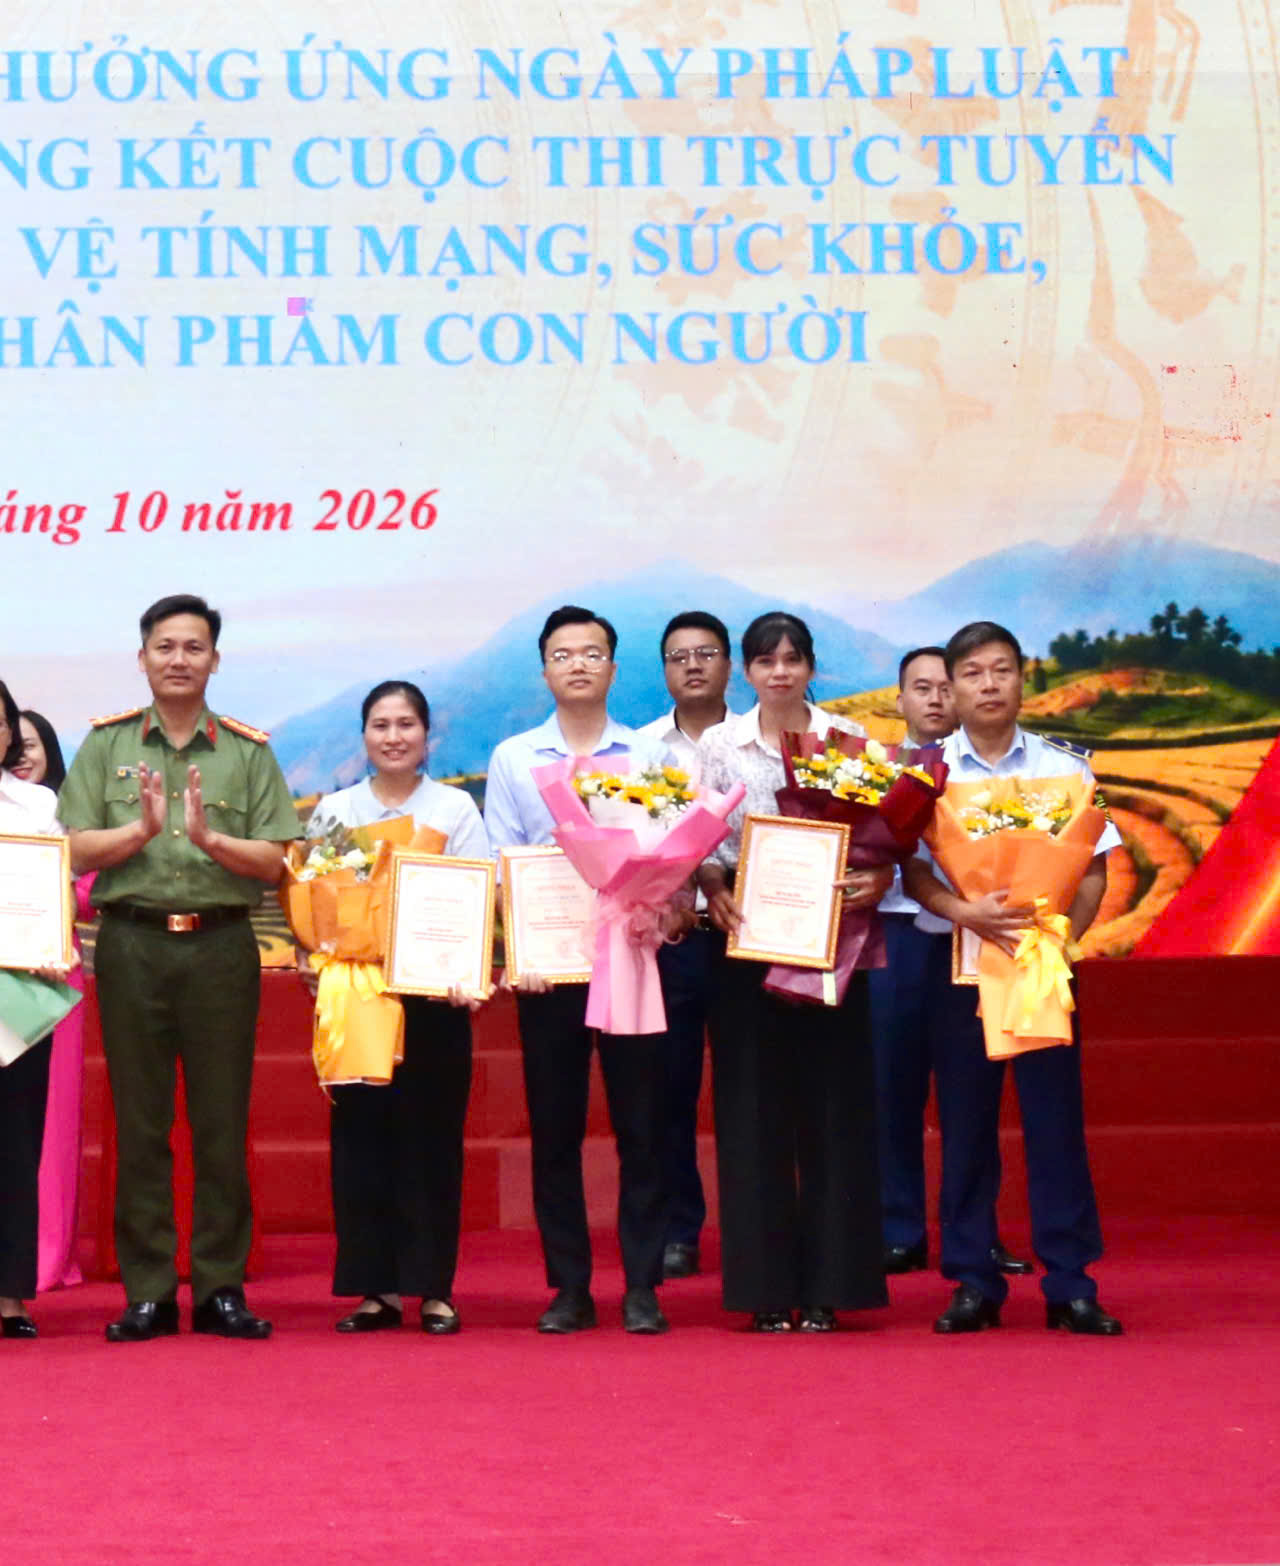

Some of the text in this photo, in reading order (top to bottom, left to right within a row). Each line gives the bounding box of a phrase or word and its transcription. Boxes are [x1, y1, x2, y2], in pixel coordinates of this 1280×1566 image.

[282, 31, 453, 102] ỨNG
[474, 30, 693, 101] NGÀY
[711, 30, 914, 100] PHÁP
[929, 36, 1130, 114] LUẬT
[116, 119, 274, 191] KẾT
[291, 127, 511, 205] CUỘC
[531, 134, 666, 189] THI
[685, 125, 902, 202] TRỰC
[920, 116, 1178, 188] TUYẾN
[17, 216, 119, 295] VỆ
[139, 208, 332, 280] TÍNH
[355, 223, 614, 293] MẠNG,
[632, 207, 784, 278] SỨC
[808, 206, 1048, 284] KHỎE,
[422, 311, 587, 367] CON
[611, 293, 869, 365] NGƯỜI
[106, 489, 170, 534] 10
[180, 489, 294, 534] năm
[312, 487, 440, 532] 2026
